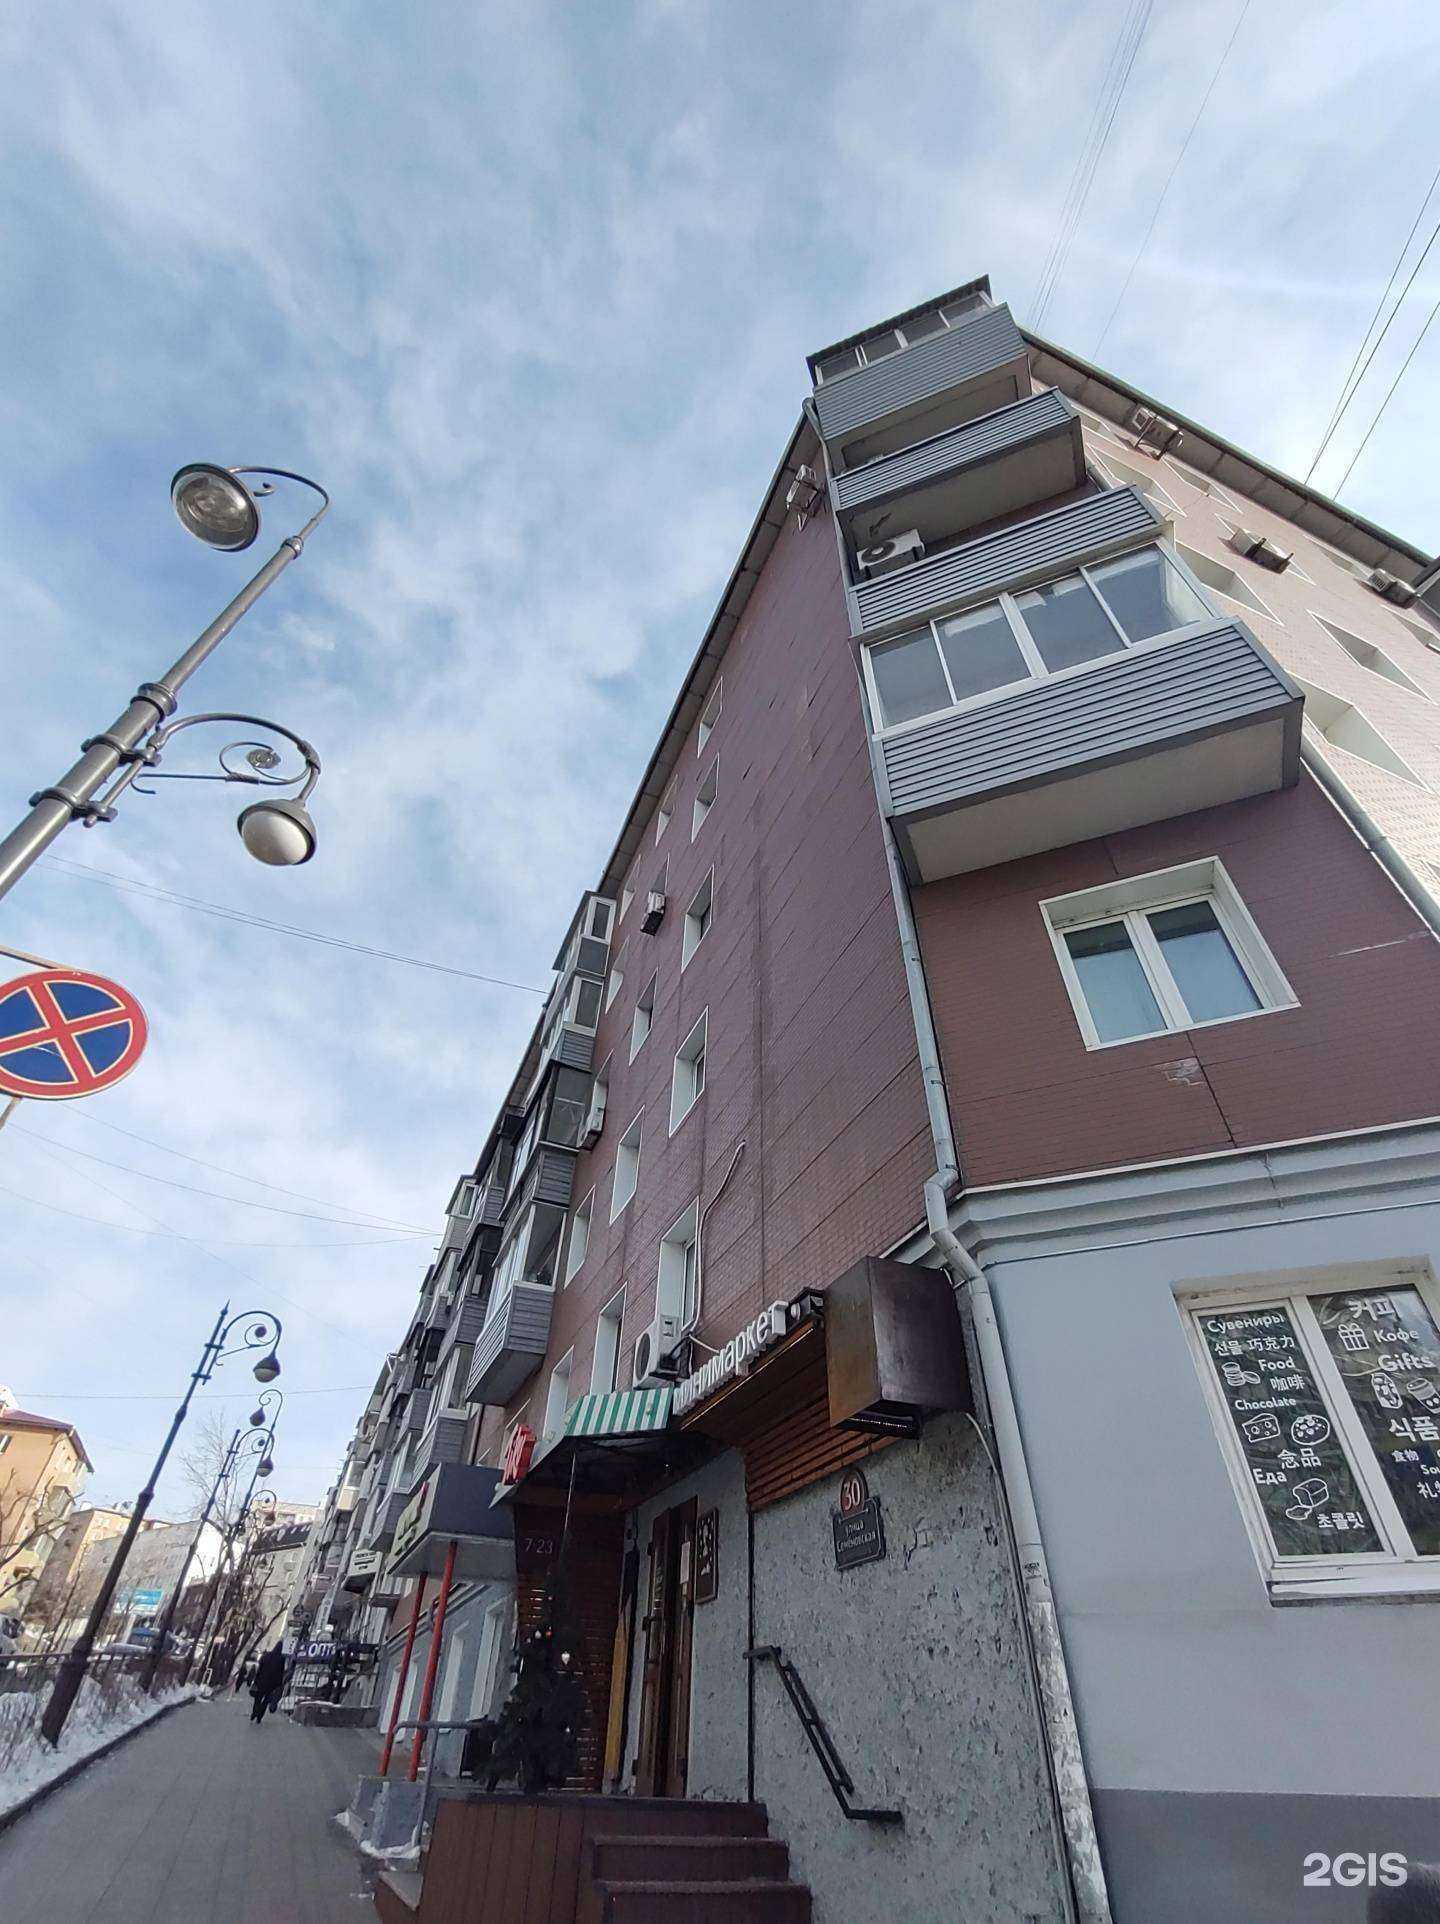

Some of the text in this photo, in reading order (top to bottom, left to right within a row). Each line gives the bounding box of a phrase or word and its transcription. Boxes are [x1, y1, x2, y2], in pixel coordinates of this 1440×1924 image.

[1347, 1298, 1398, 1322] 커피
[1207, 1314, 1285, 1333] Сувениры
[1247, 1335, 1295, 1351] 巧克力
[1373, 1327, 1420, 1343] Кофе
[1214, 1340, 1243, 1356] 선물
[1259, 1356, 1295, 1371] Food
[1378, 1352, 1436, 1371] Gifts
[1270, 1374, 1305, 1391] 咖啡
[1235, 1397, 1297, 1410] Chocolate
[1389, 1416, 1440, 1441] 식품
[1253, 1468, 1287, 1485] Еда
[842, 1479, 860, 1510] 30
